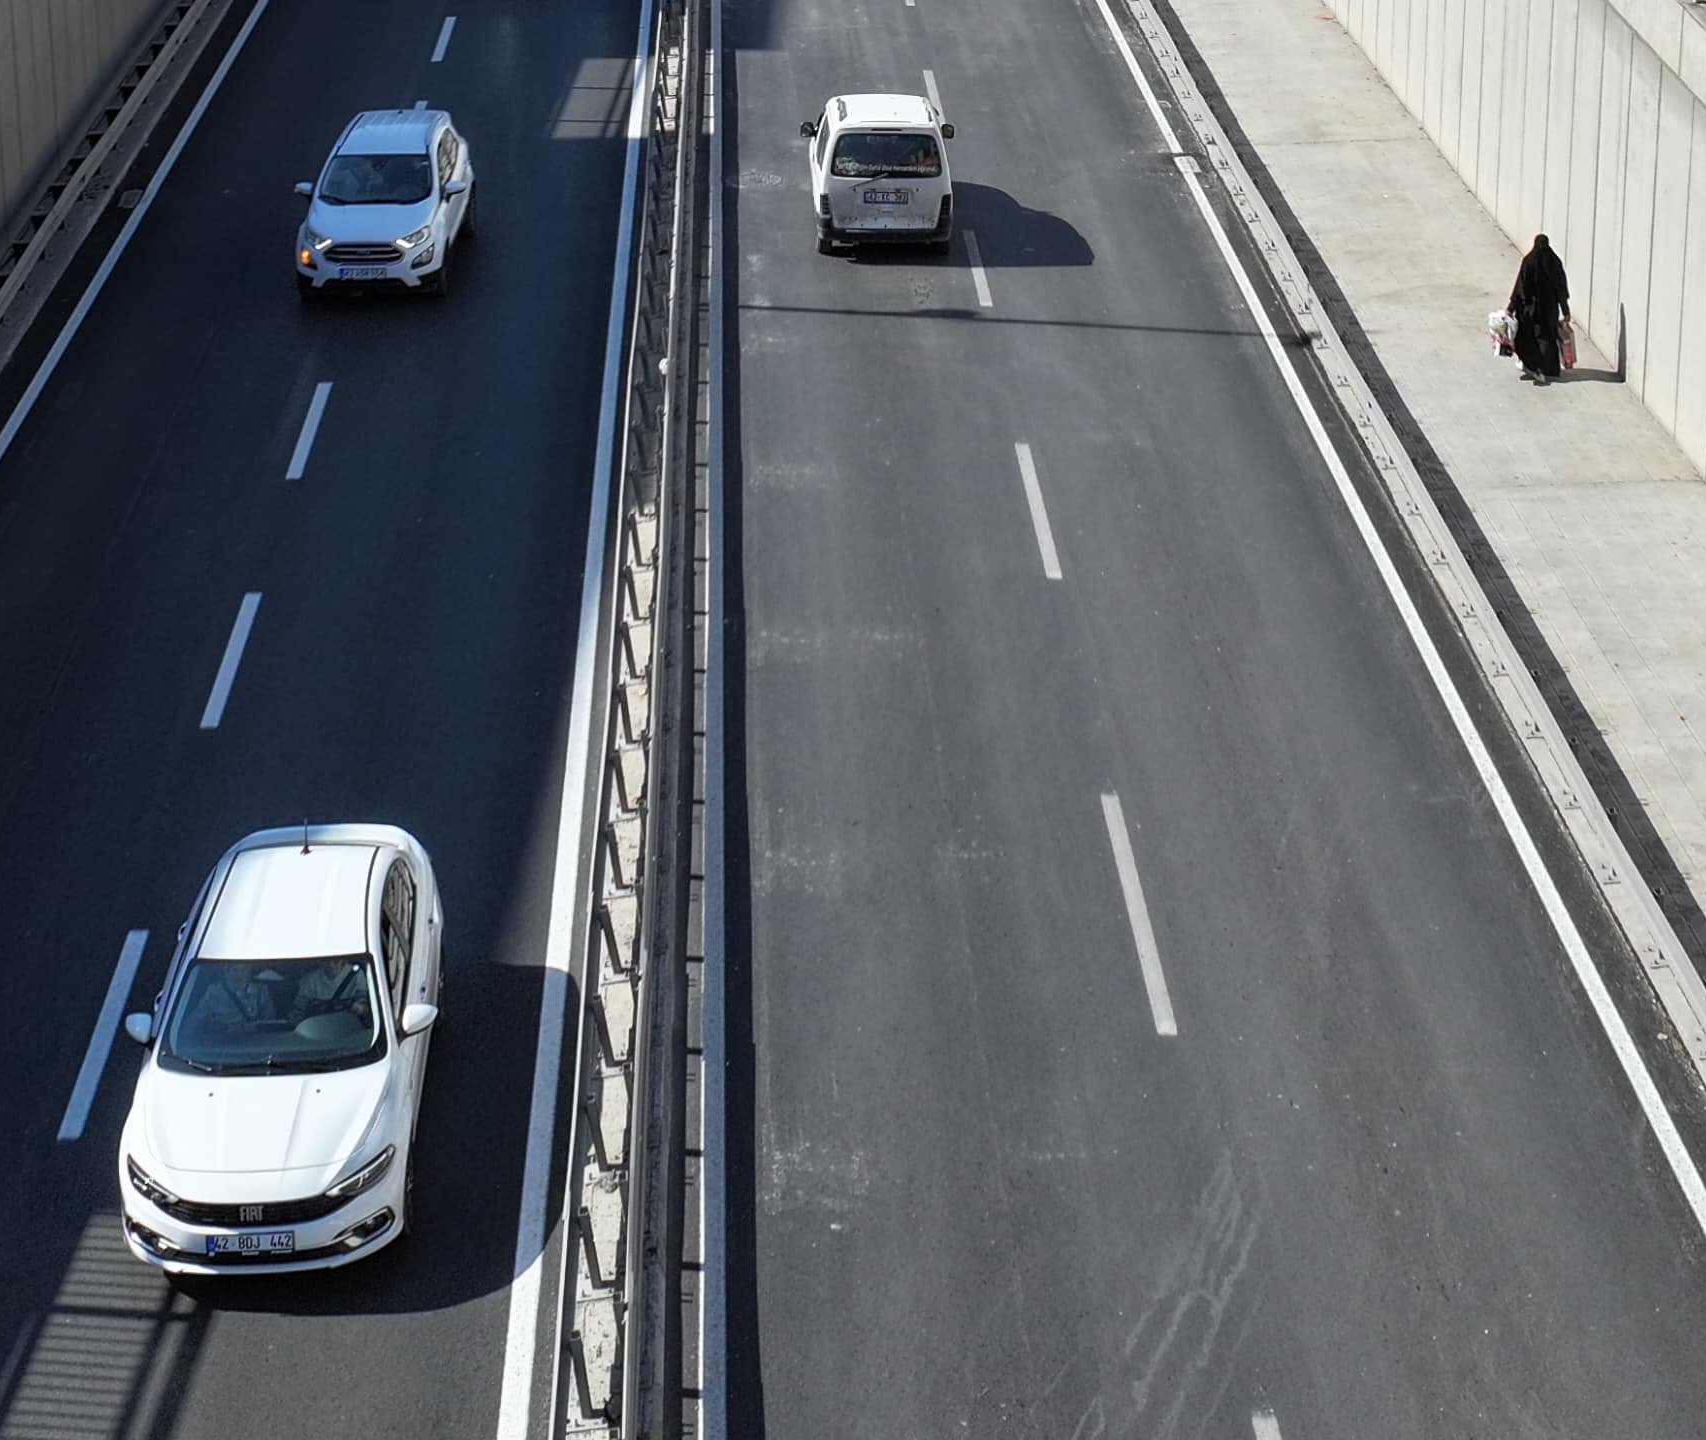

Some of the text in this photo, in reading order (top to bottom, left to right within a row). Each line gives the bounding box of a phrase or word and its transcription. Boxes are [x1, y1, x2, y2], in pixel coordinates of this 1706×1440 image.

[239, 1206, 263, 1221] FIAT
[214, 1234, 292, 1250] 42 BDJ 442
